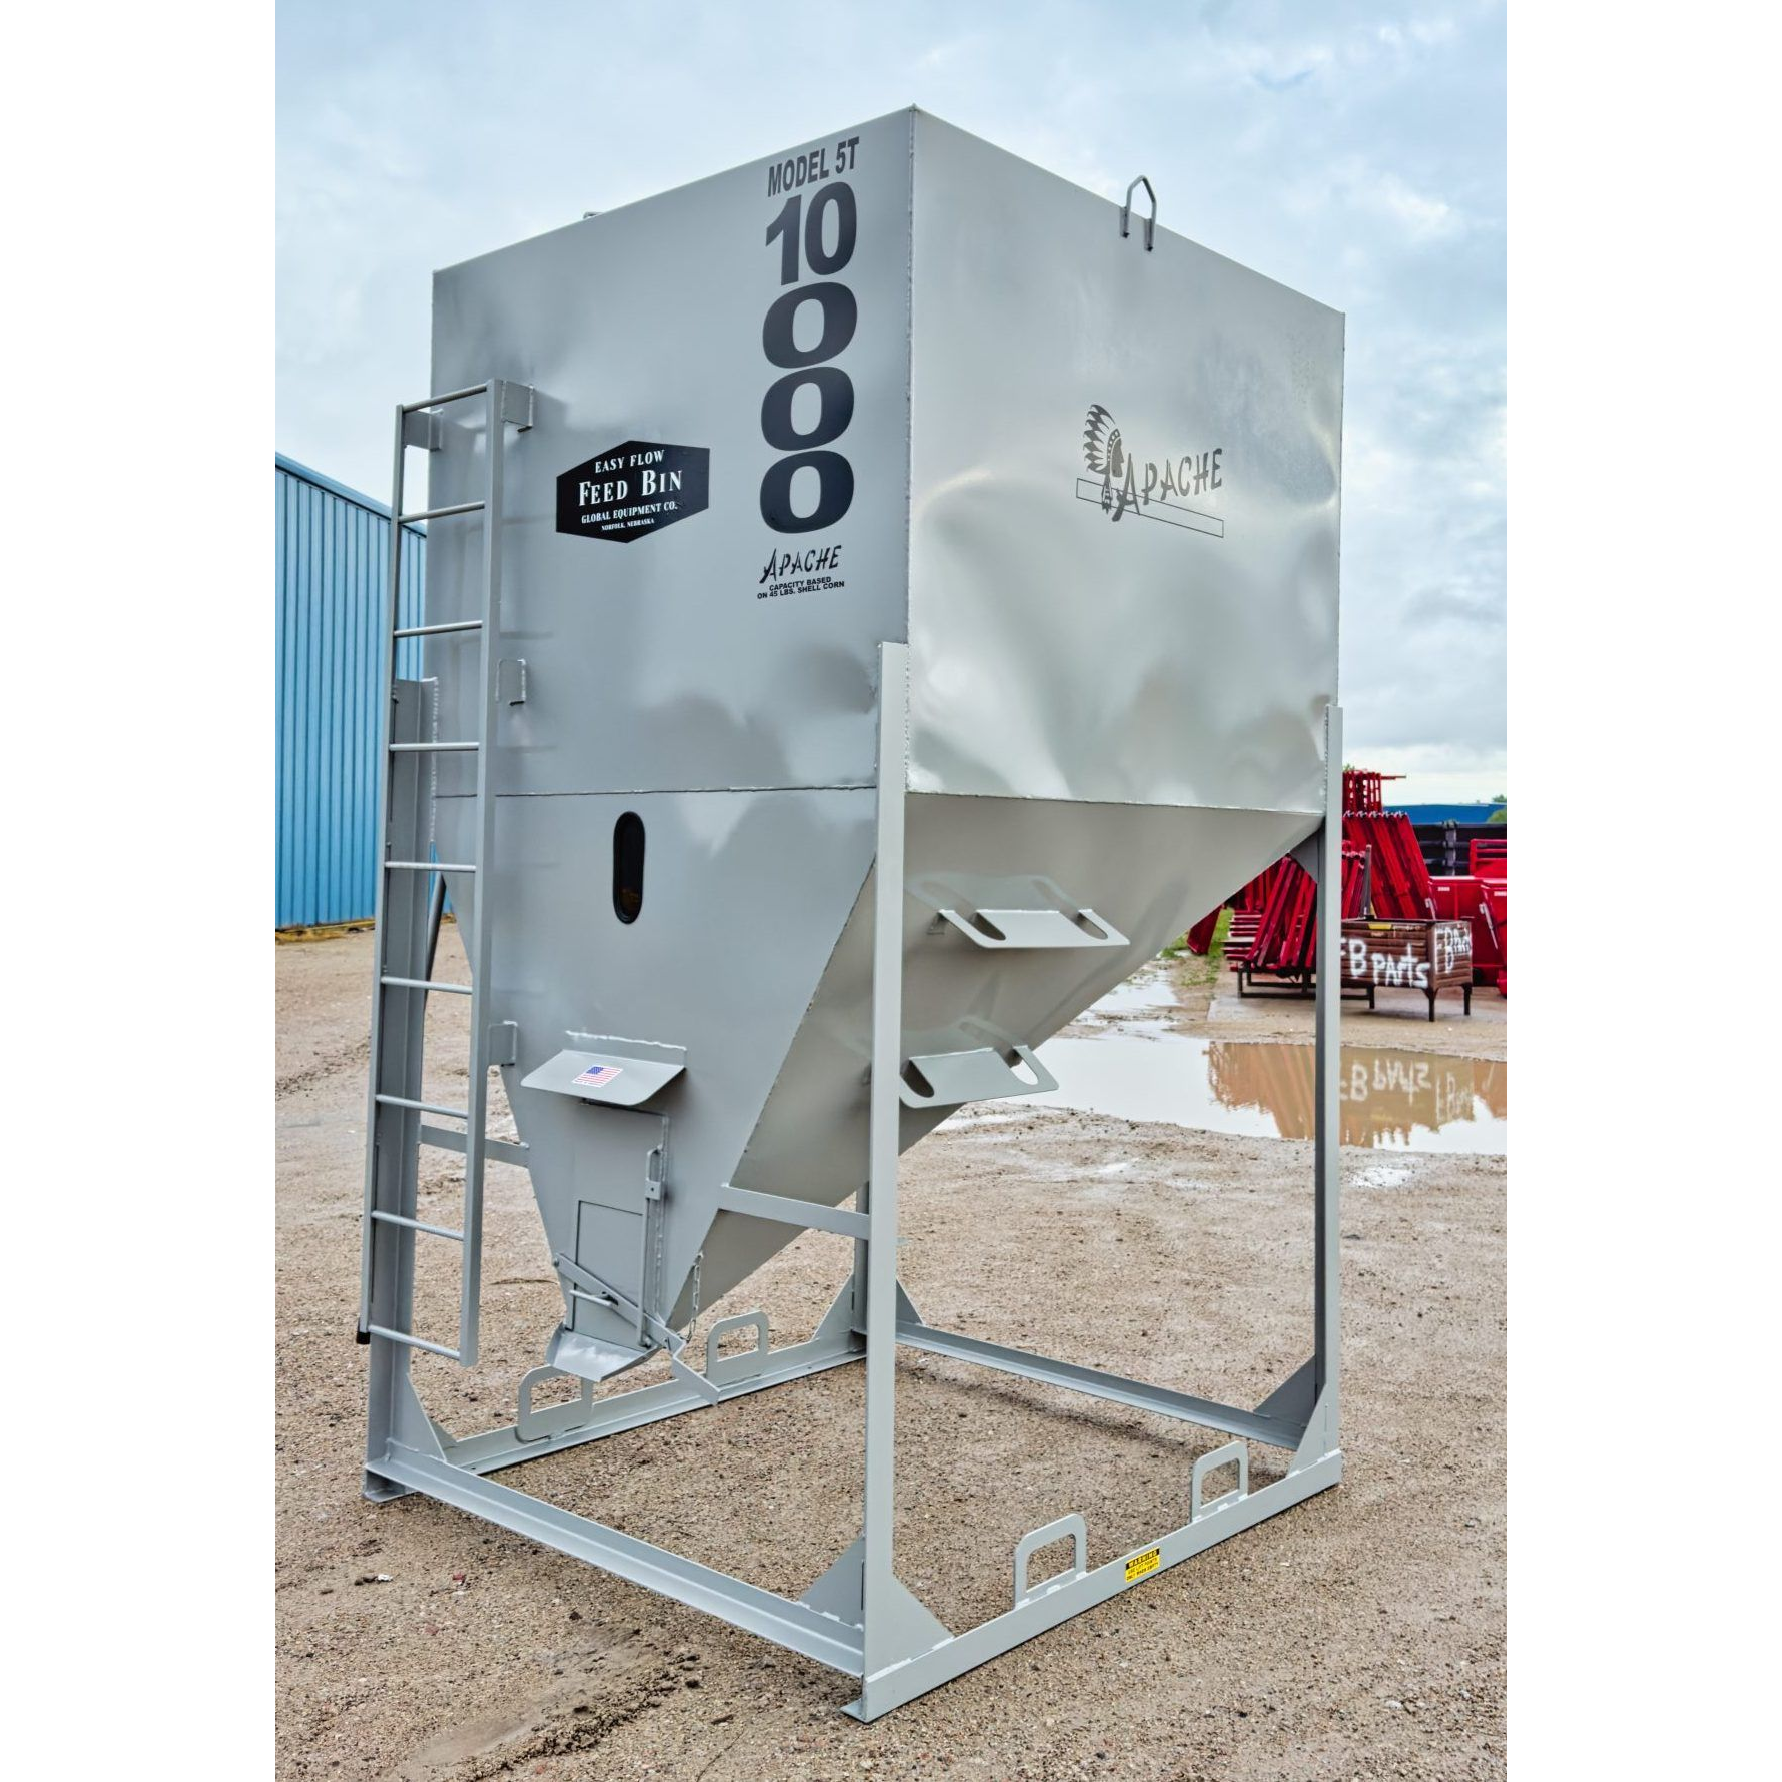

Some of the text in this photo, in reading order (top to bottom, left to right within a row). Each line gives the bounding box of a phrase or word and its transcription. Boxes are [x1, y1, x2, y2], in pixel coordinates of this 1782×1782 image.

[767, 136, 860, 198] MODEL 5T
[595, 449, 665, 474] EASY FLOW
[578, 469, 683, 507] FEED BIN
[581, 500, 678, 524] GLOBAL EQUIPMENT CO.
[627, 518, 655, 528] NEBRASKA
[759, 545, 842, 584] APACHE
[757, 592, 768, 600] ON
[780, 588, 796, 596] LBS.
[797, 585, 821, 594] SHELL
[823, 581, 845, 590] CORN
[769, 576, 832, 591] CAPACITY BASED
[1128, 1550, 1157, 1568] WARNING
